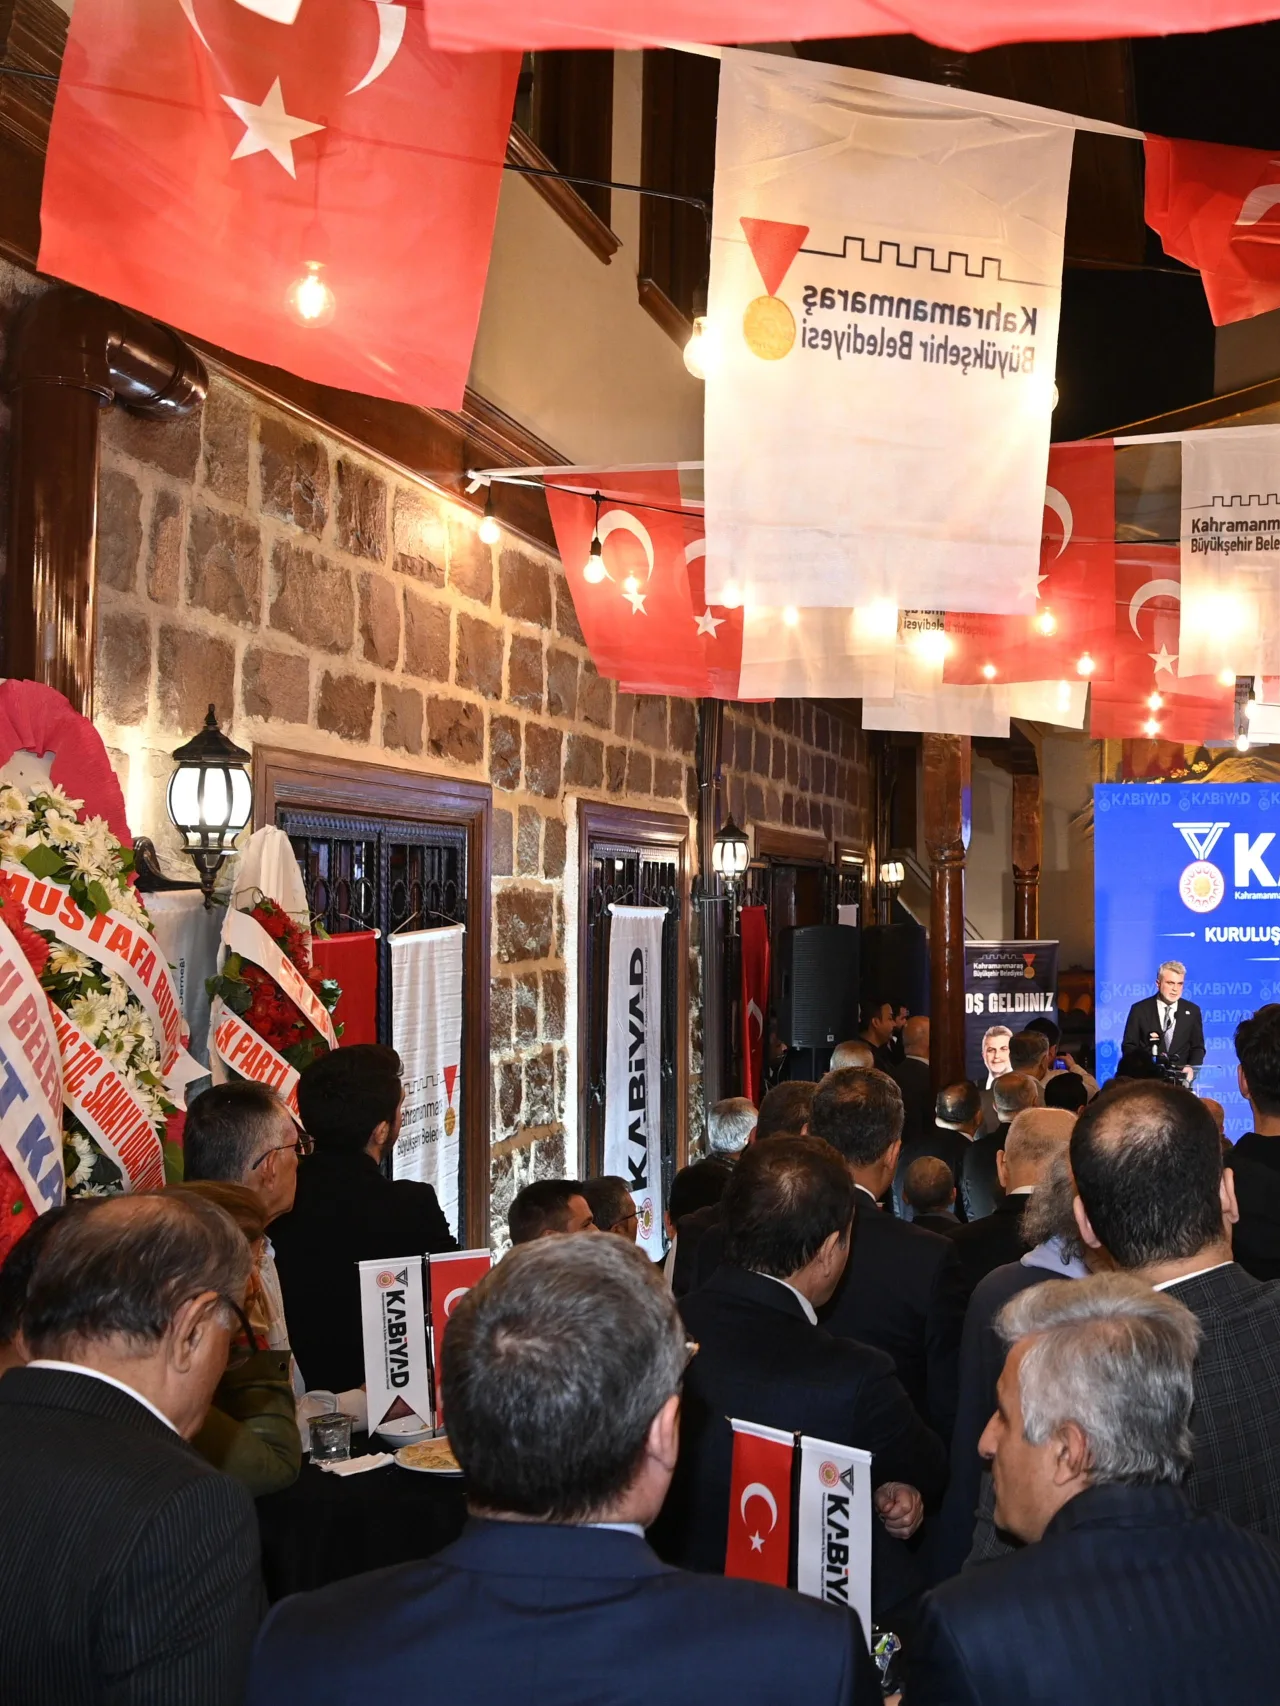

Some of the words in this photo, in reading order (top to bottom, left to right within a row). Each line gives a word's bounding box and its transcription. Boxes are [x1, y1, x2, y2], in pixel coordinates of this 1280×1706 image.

[1190, 536, 1253, 556] Büyükşehir
[973, 962, 1024, 971] Kahramanmaraş
[1000, 970, 1024, 978] Belediyesi
[965, 993, 984, 1015] OŞ
[988, 992, 1054, 1013] GELDİNİZ
[228, 1032, 292, 1092] PARTİ
[627, 946, 648, 1193] KABİYAD
[386, 1289, 410, 1389] KABİYAD
